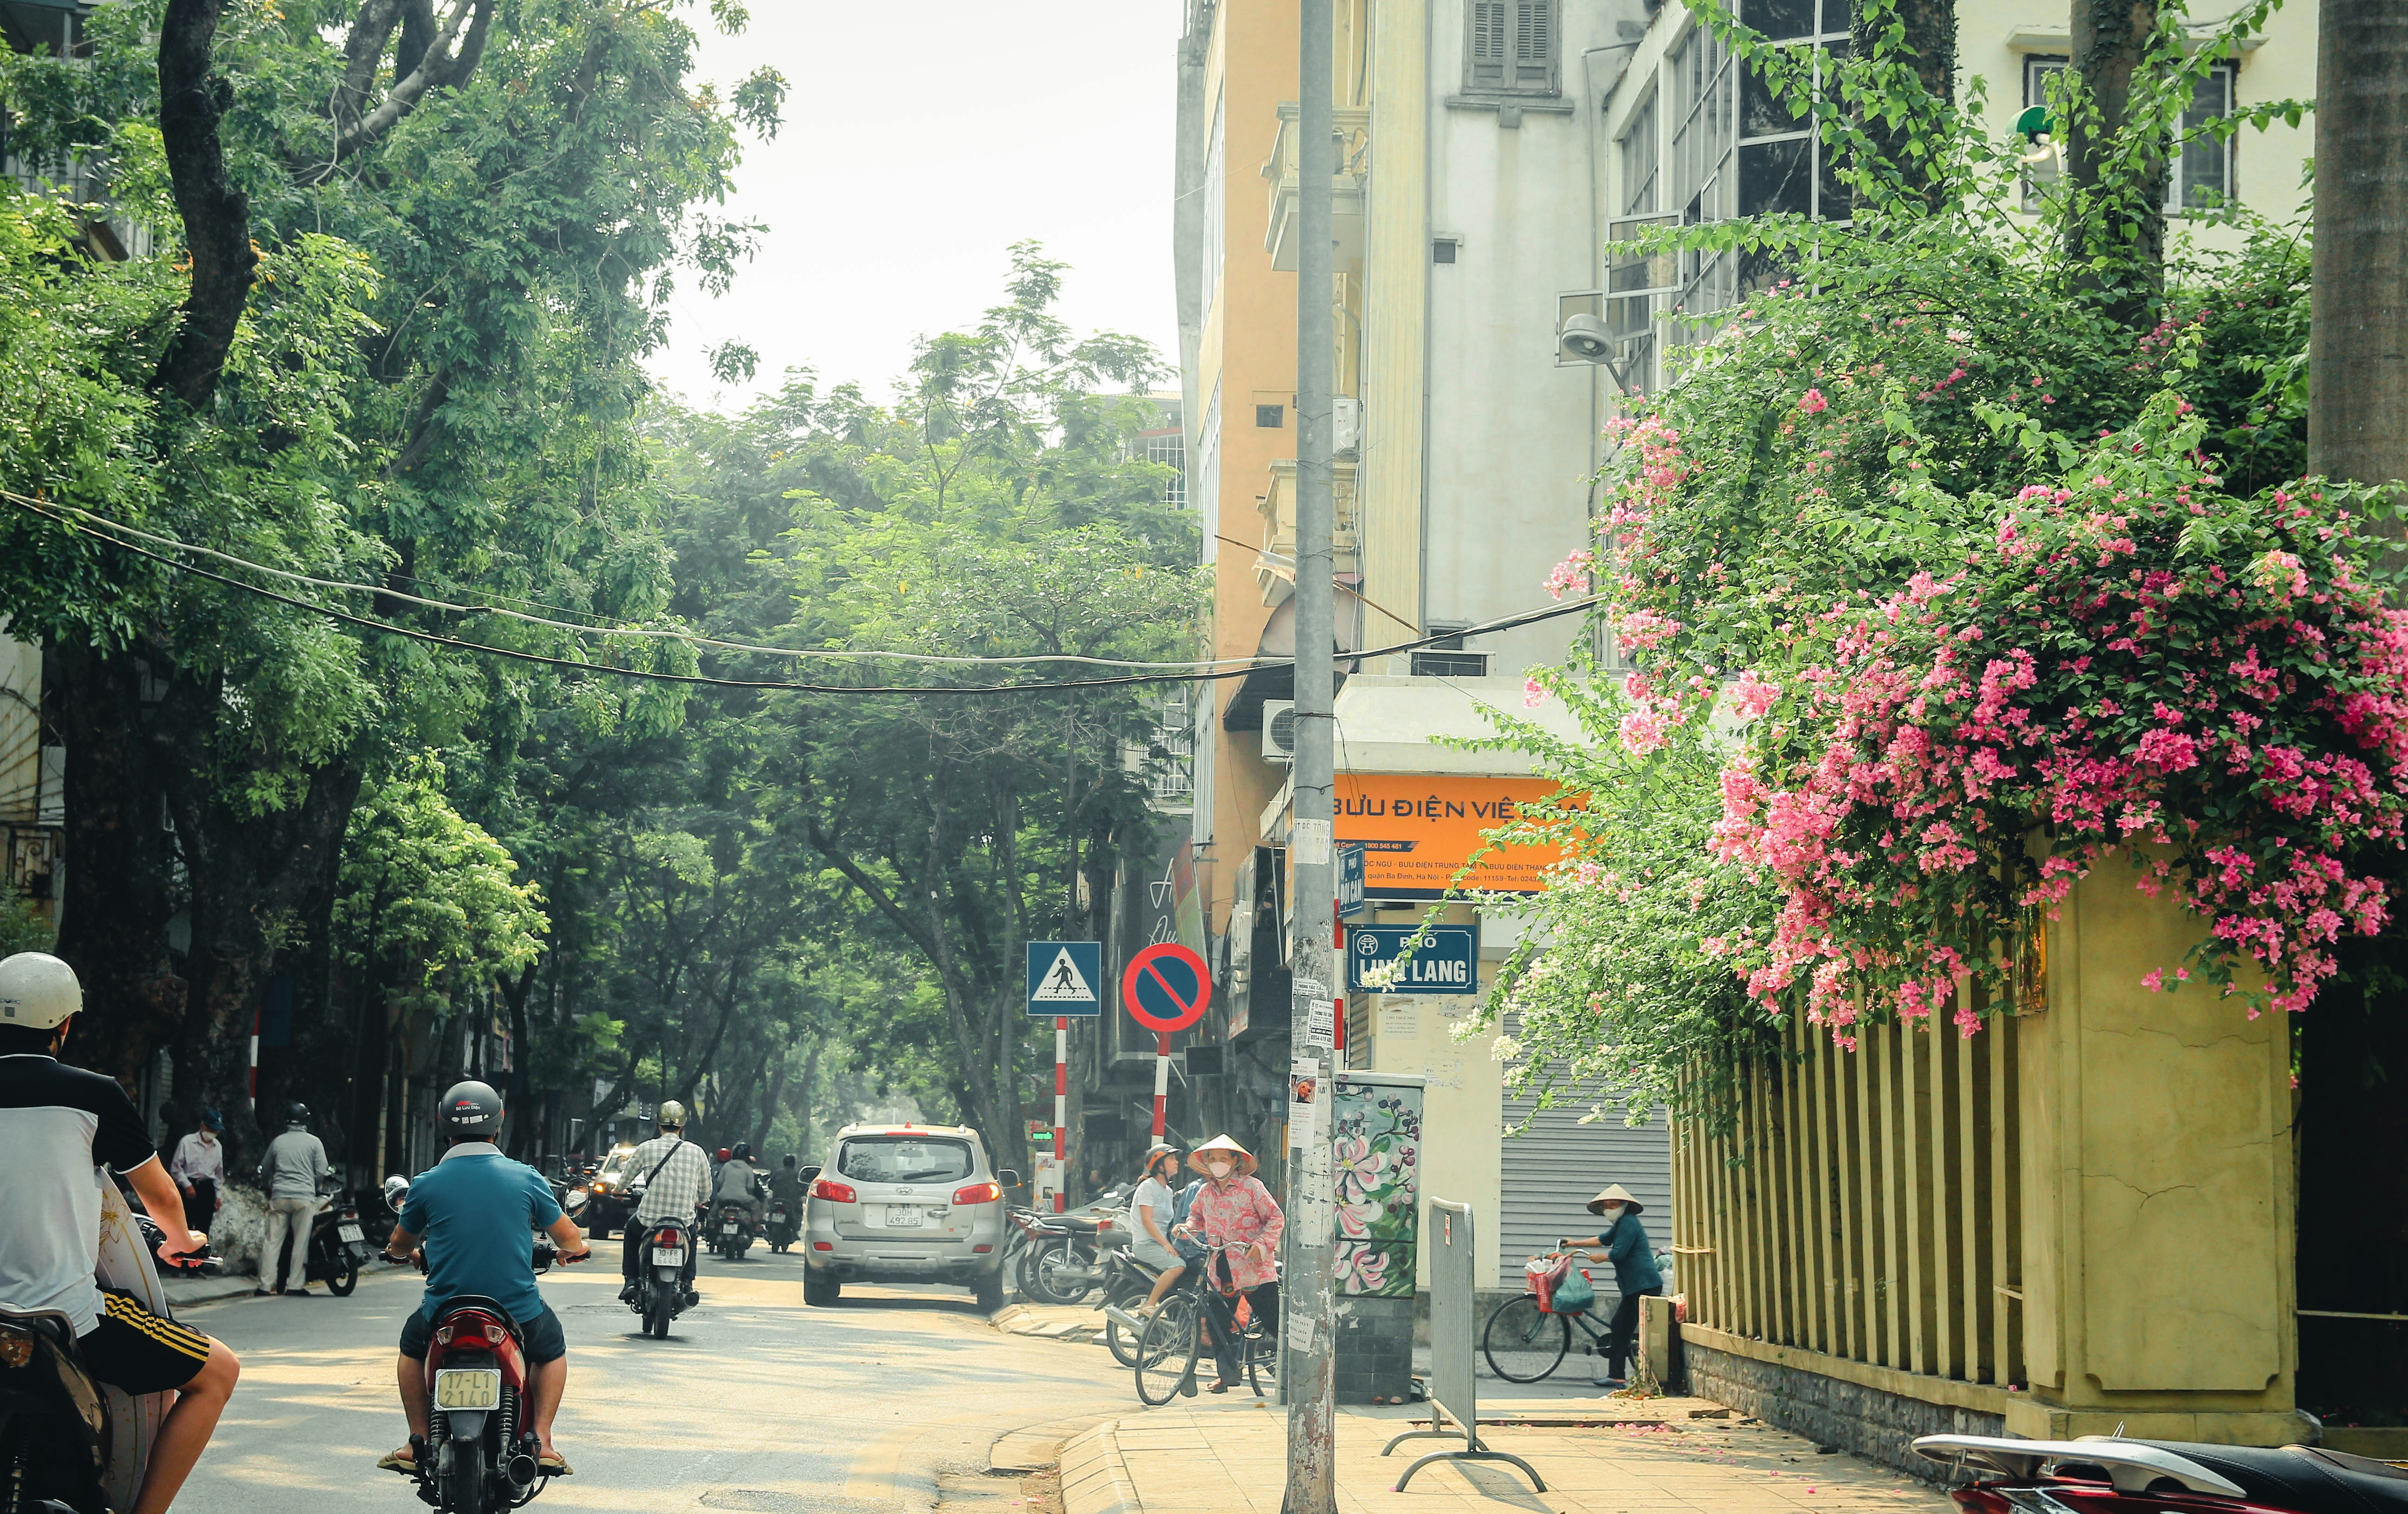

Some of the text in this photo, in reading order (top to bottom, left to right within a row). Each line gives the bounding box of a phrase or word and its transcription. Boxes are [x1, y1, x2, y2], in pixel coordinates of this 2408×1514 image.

[1334, 794, 1385, 816] BƯU
[1392, 795, 1465, 822] ĐIỆN
[1348, 852, 1357, 870] PHỐ
[1413, 959, 1466, 983] LANG
[896, 1208, 912, 1217] 30H
[447, 1372, 489, 1389] 17-L1
